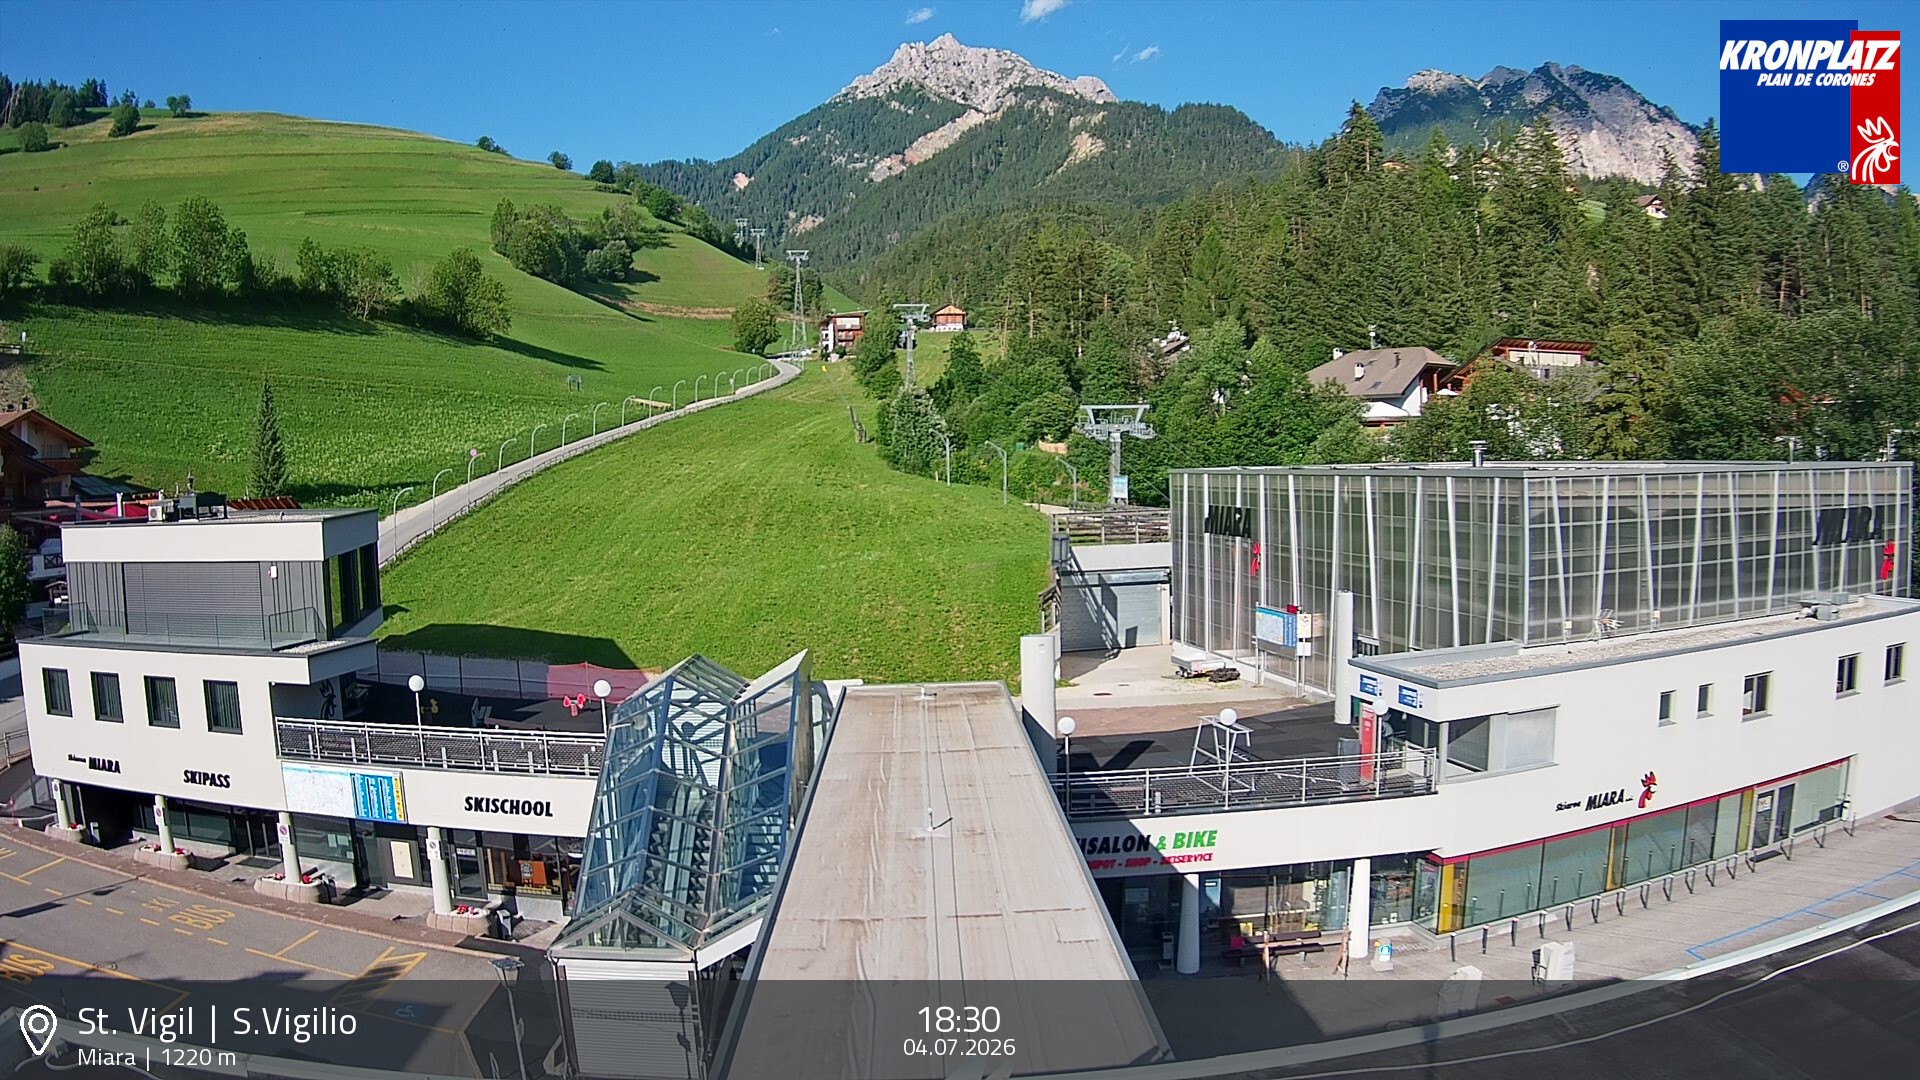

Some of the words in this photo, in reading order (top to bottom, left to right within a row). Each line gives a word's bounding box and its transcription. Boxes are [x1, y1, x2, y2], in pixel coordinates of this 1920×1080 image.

[1204, 505, 1252, 538] MIARA
[89, 757, 121, 774] MIARA
[183, 769, 231, 788] SKIPASS
[464, 796, 553, 817] SKISCHOOL
[1585, 788, 1625, 811] MIARA
[1156, 835, 1166, 850] &
[1173, 830, 1217, 849] BIKE
[168, 904, 236, 930] BUS
